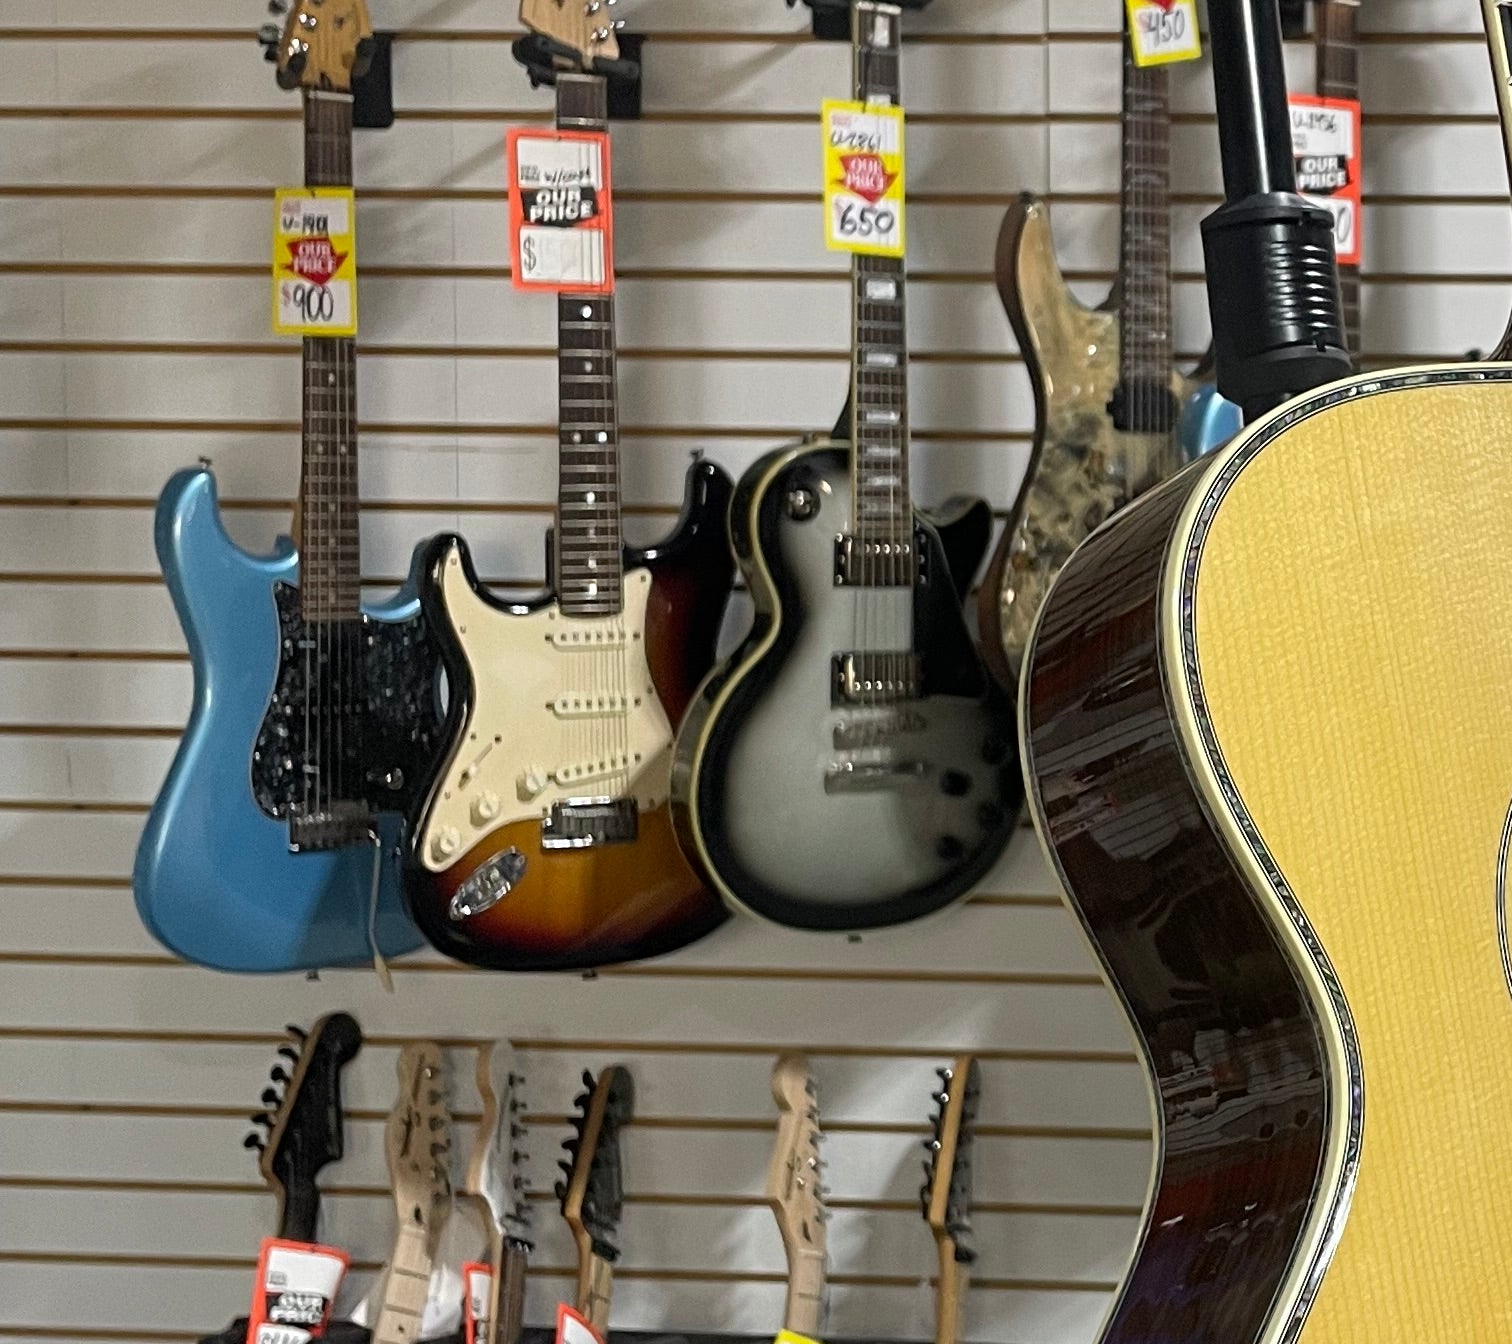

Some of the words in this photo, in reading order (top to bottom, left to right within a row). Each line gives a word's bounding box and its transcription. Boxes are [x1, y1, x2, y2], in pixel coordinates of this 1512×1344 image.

[1303, 157, 1338, 173] OUR
[1298, 171, 1347, 189] PRICE
[536, 187, 581, 205] OUR
[530, 203, 594, 224] PRICE
[297, 240, 331, 257] OUR
